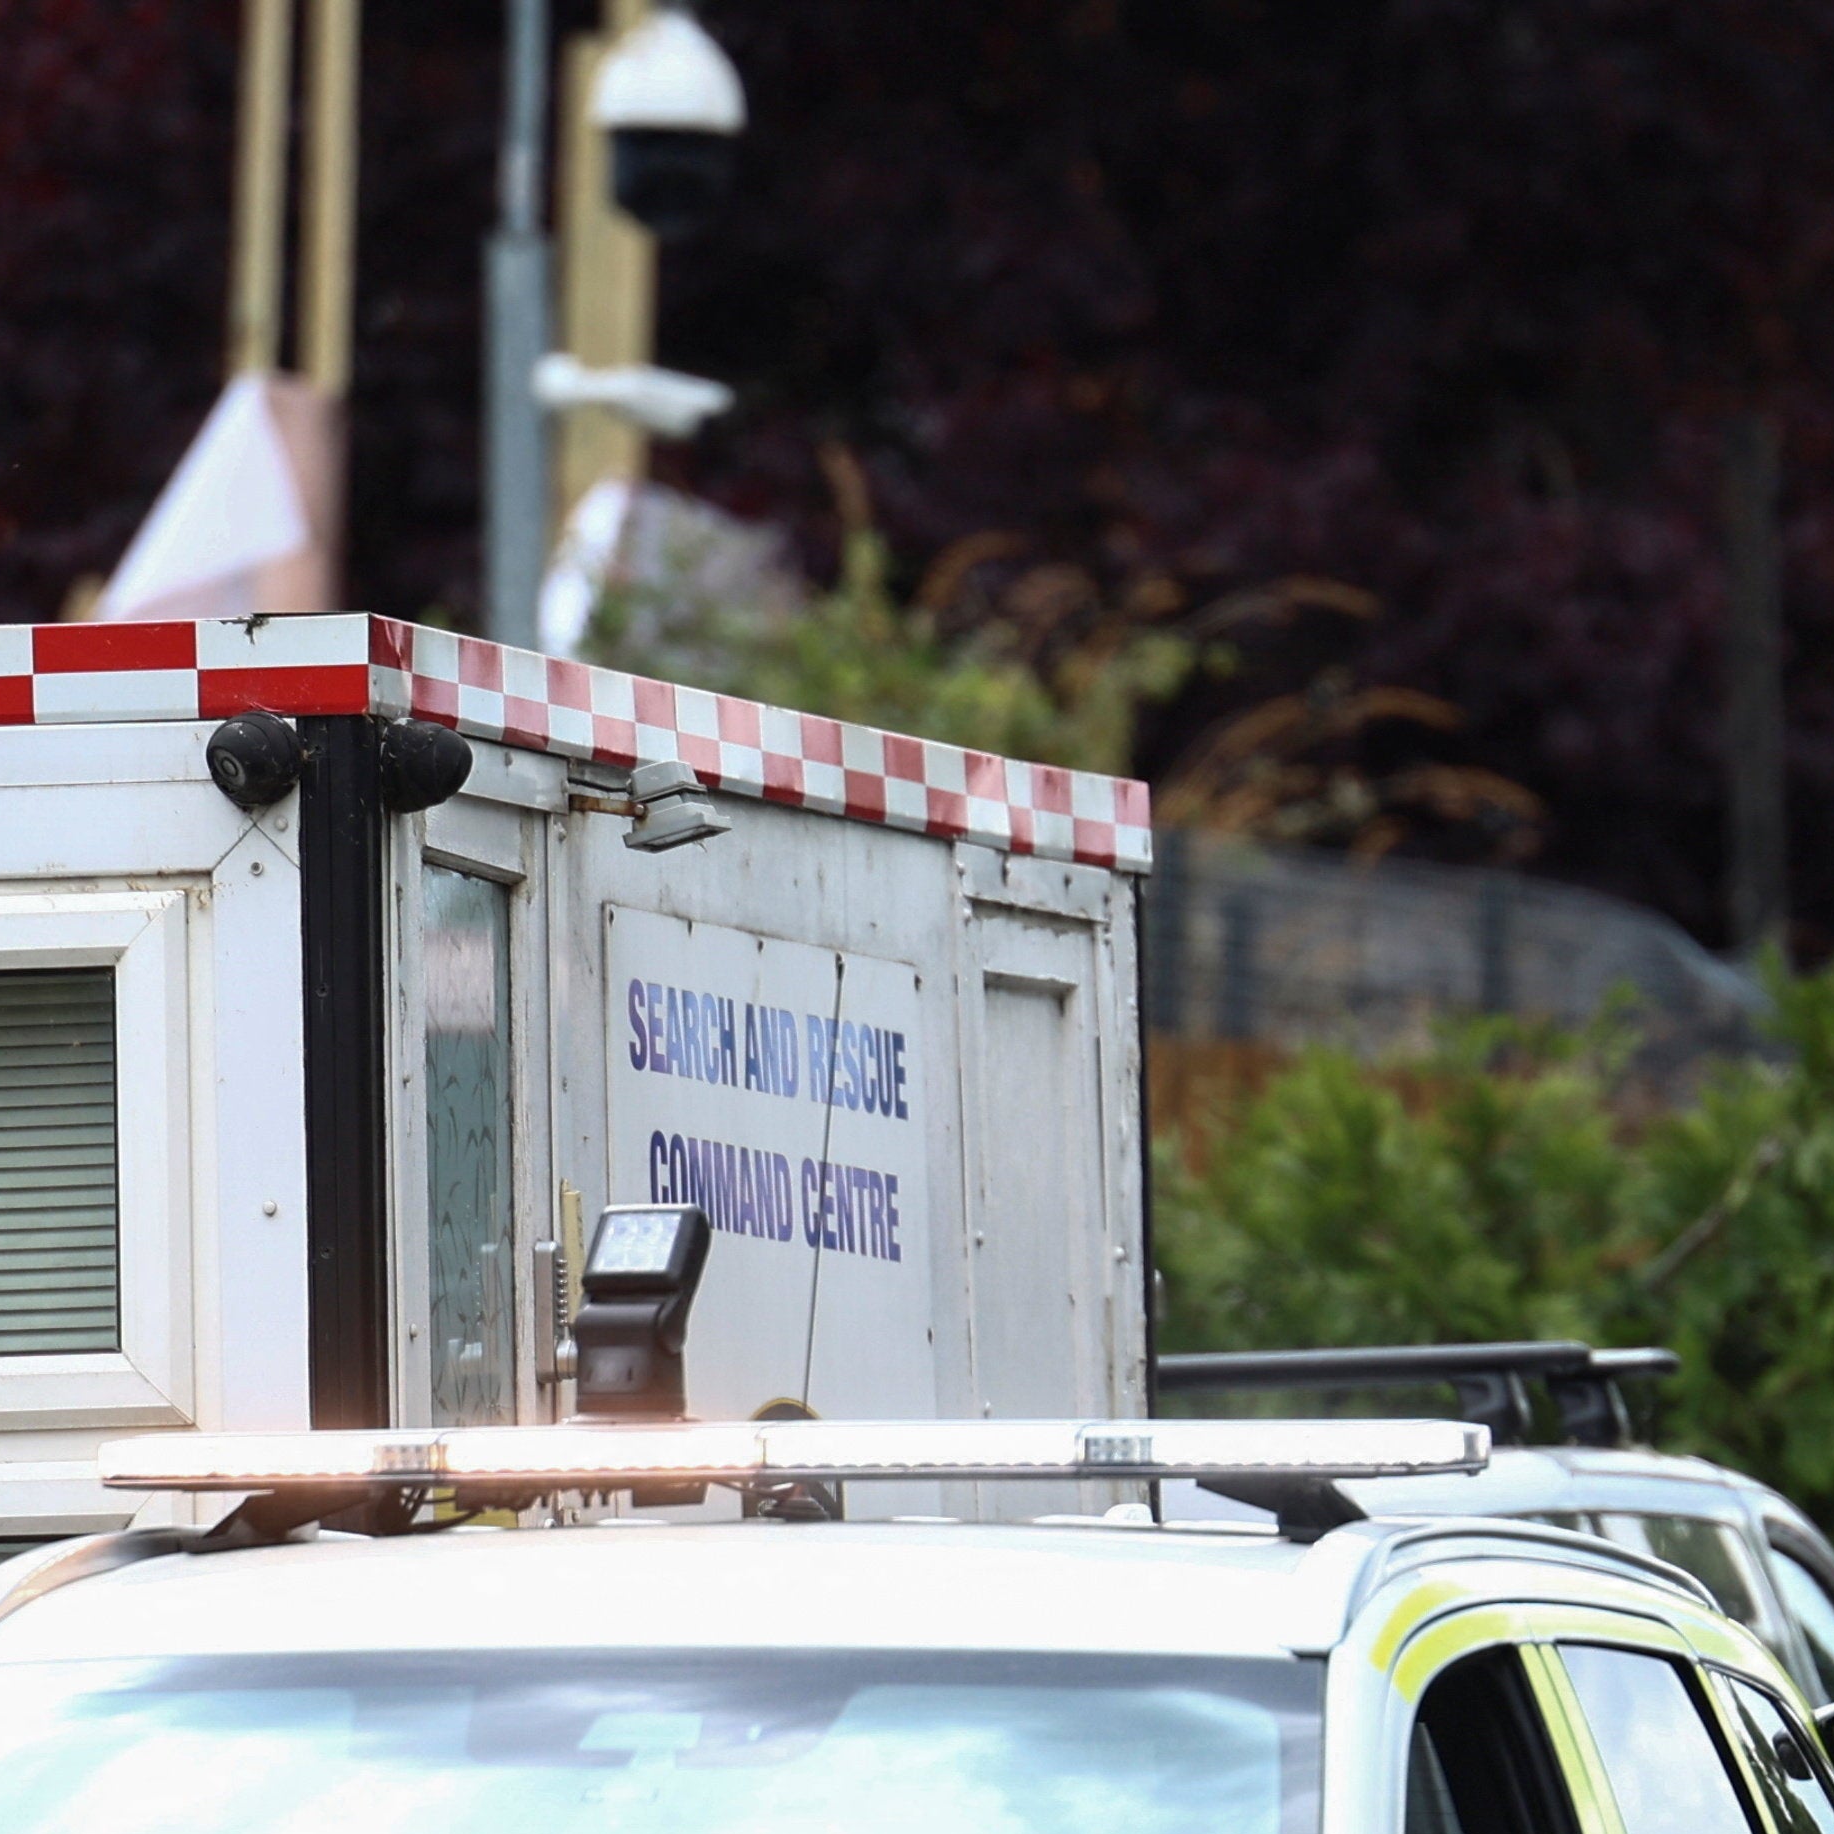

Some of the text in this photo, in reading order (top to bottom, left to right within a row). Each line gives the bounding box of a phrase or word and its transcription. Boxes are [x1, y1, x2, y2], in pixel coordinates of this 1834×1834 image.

[628, 978, 909, 1120] SEARCH AND RESCUE
[649, 1130, 902, 1262] COMMAND CENTRE
